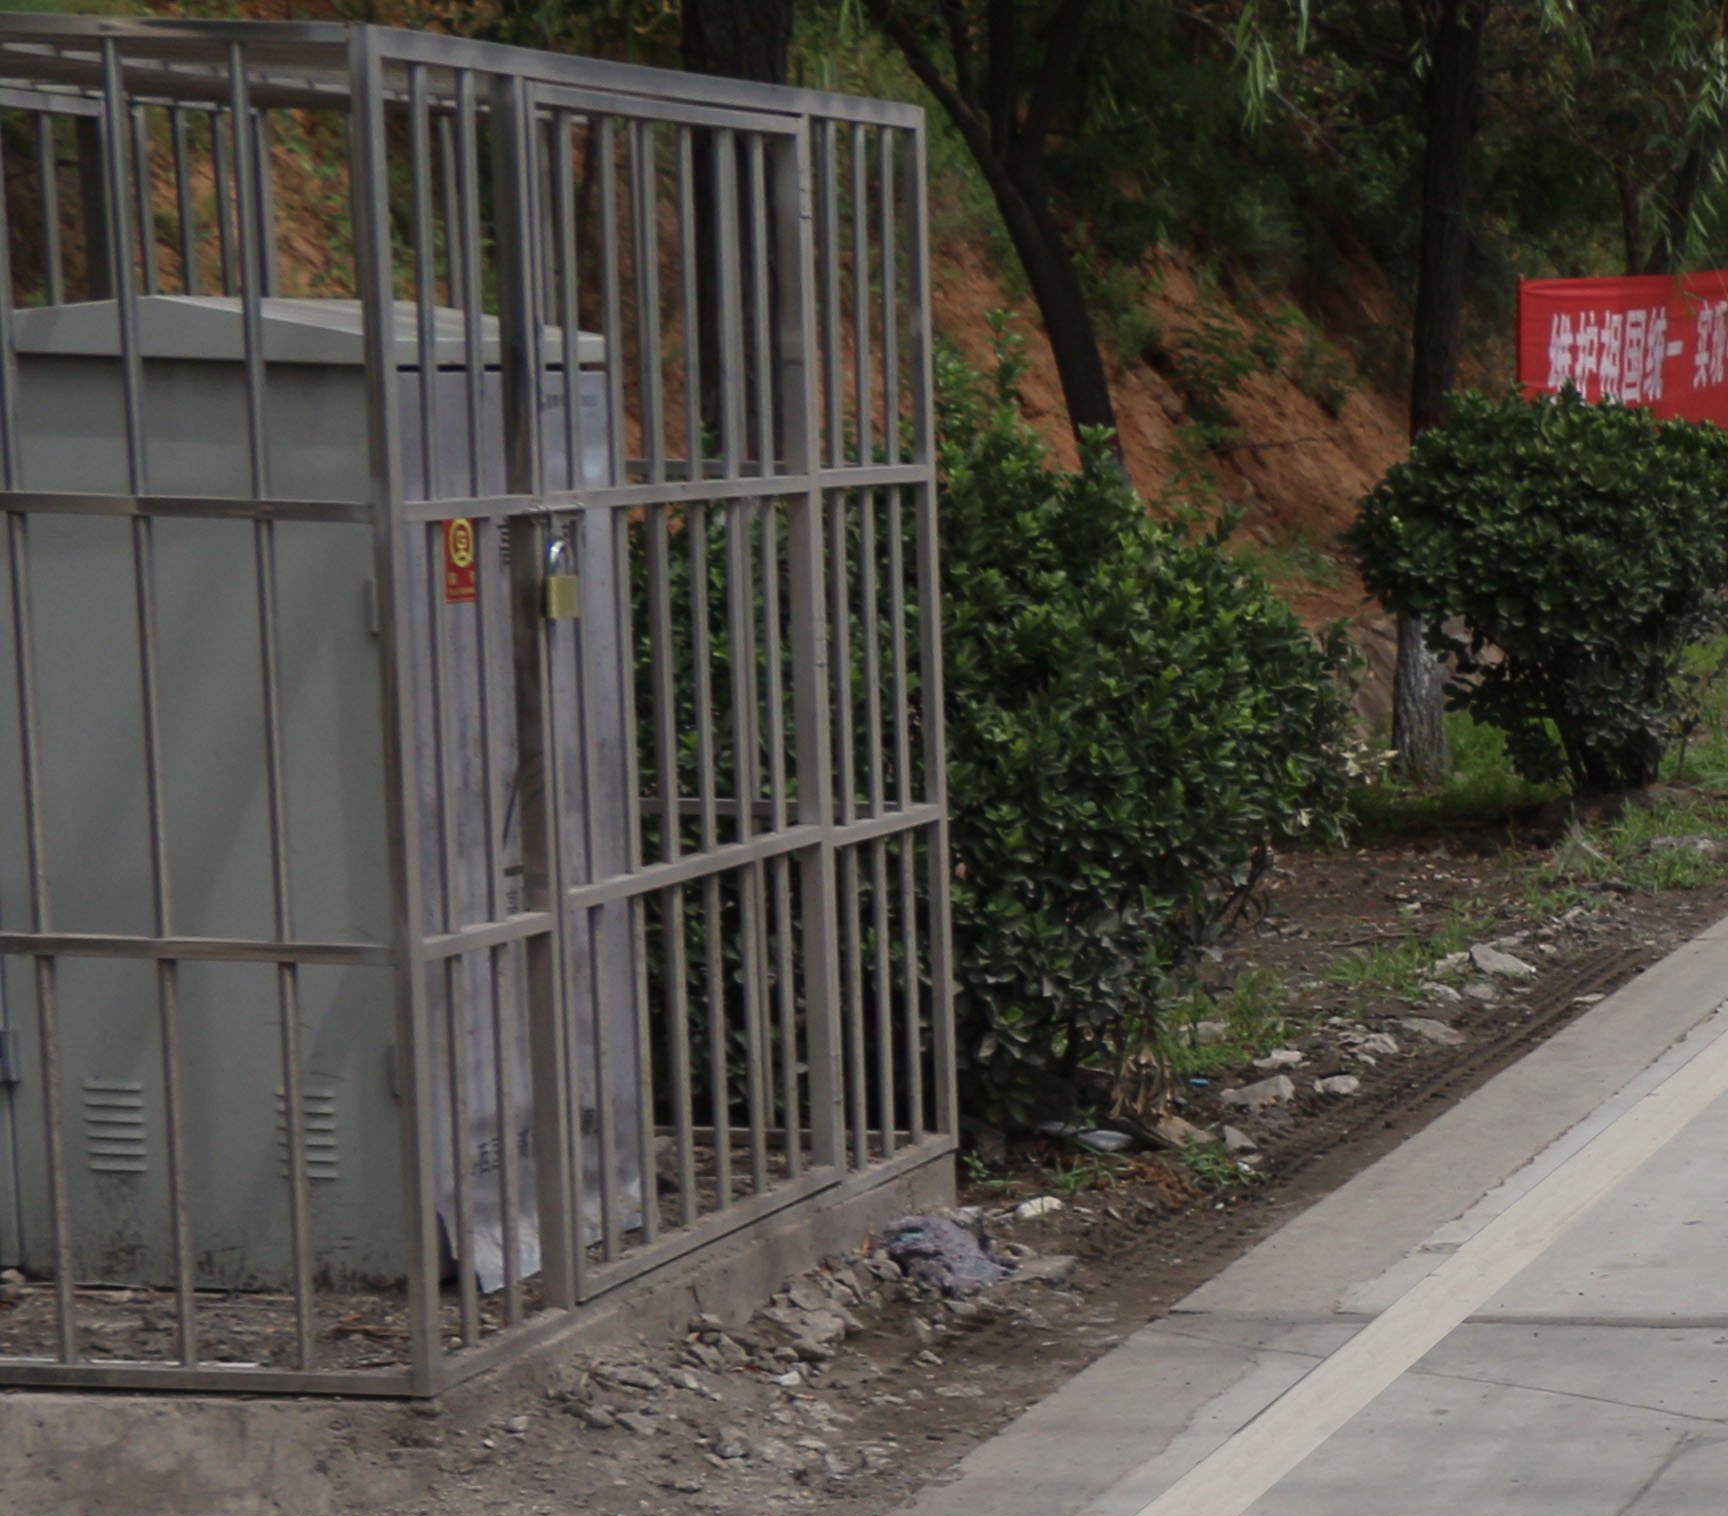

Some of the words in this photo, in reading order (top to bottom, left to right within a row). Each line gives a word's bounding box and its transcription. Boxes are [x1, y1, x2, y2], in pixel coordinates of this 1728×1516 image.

[1548, 306, 1684, 404] 维护祖国统一
